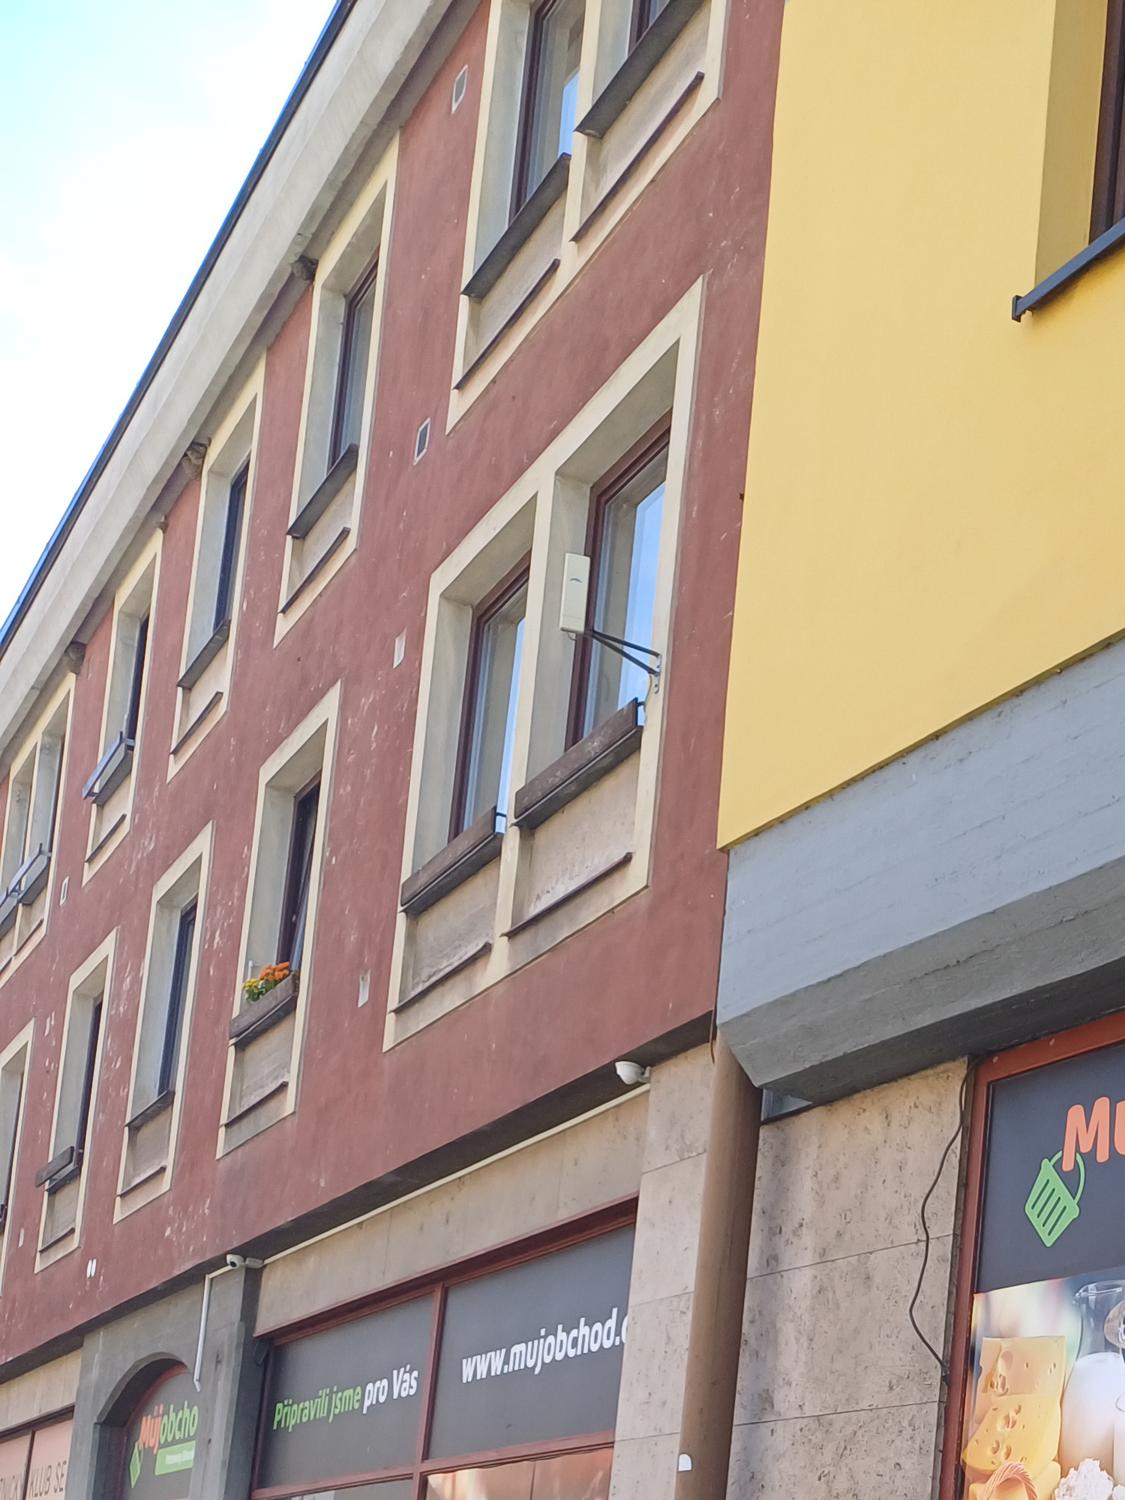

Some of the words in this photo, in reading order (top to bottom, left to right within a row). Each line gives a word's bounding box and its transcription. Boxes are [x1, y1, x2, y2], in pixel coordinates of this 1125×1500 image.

[329, 1385, 362, 1424] jsme
[363, 1378, 388, 1414] pro
[392, 1364, 419, 1400] Vás
